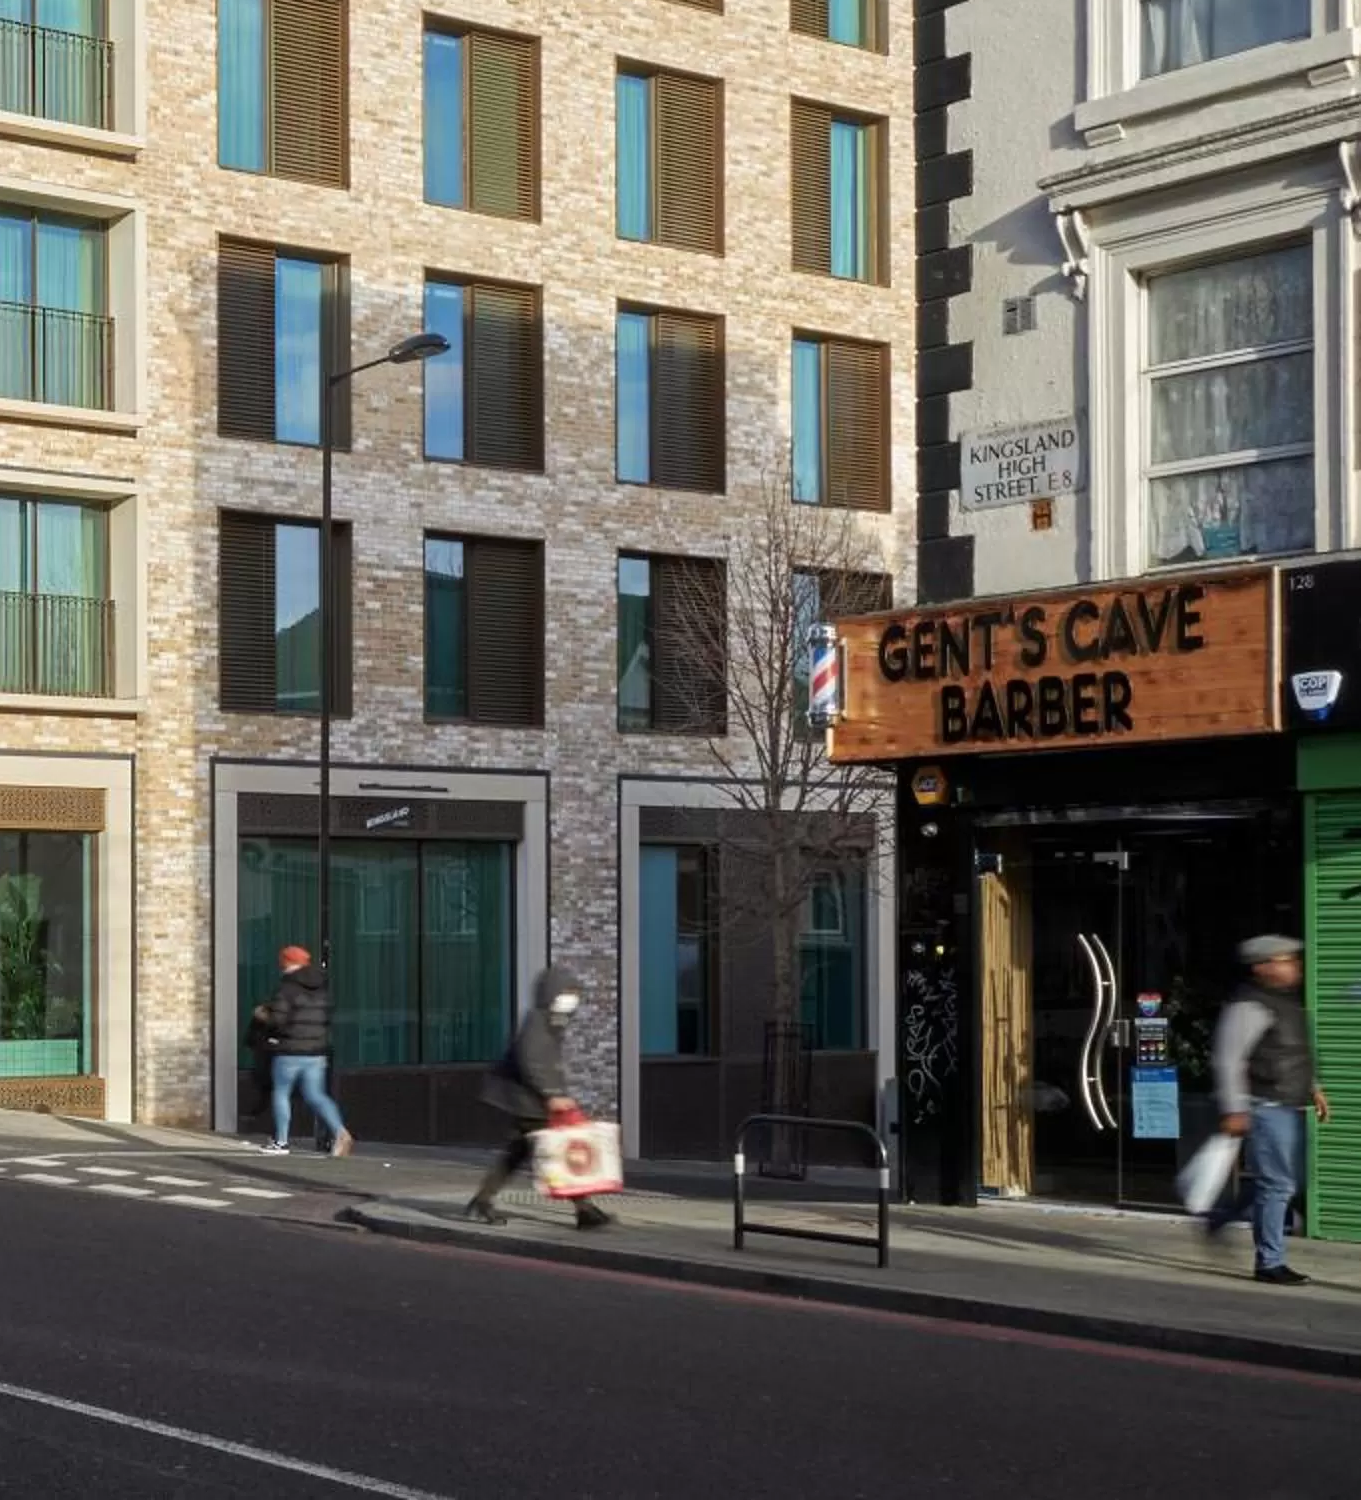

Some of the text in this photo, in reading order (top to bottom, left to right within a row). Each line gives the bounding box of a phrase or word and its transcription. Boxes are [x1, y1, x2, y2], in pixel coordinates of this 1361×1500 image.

[970, 430, 1075, 464] KINGSLAND
[998, 454, 1046, 479] HIGH
[1290, 575, 1315, 591] 128
[878, 583, 1205, 683] GENT'S CAVE
[939, 670, 1134, 743] BARBER
